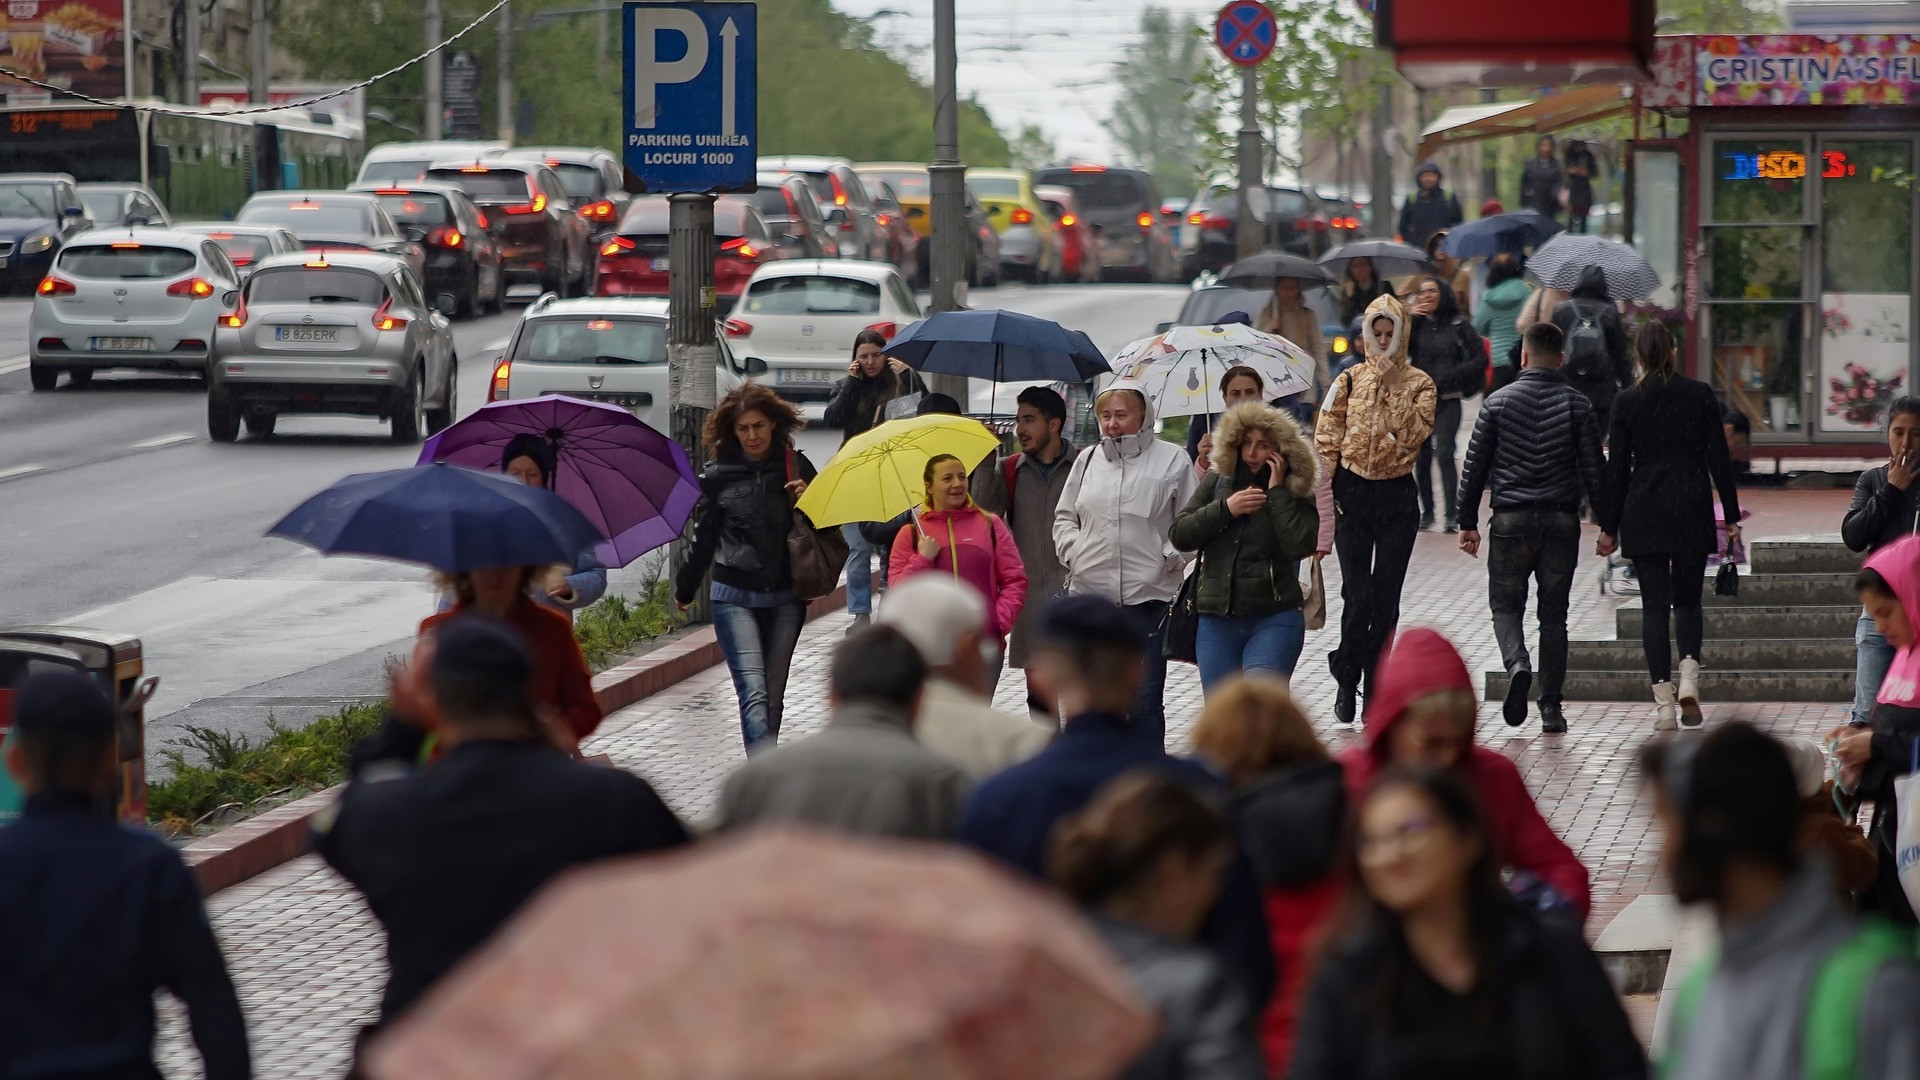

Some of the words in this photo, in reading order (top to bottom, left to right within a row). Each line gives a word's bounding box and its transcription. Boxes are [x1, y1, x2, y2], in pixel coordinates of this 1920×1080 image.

[635, 8, 709, 129] P
[1709, 58, 1880, 82] CRISTINA'S
[1893, 58, 1920, 82] FL
[10, 112, 38, 133] 312
[629, 135, 692, 147] PARKING
[696, 135, 749, 147] UNIREA
[644, 153, 697, 165] LOCURI
[701, 153, 734, 165] 1000
[282, 330, 290, 340] B
[293, 330, 312, 340] 825
[313, 330, 337, 341] ERK
